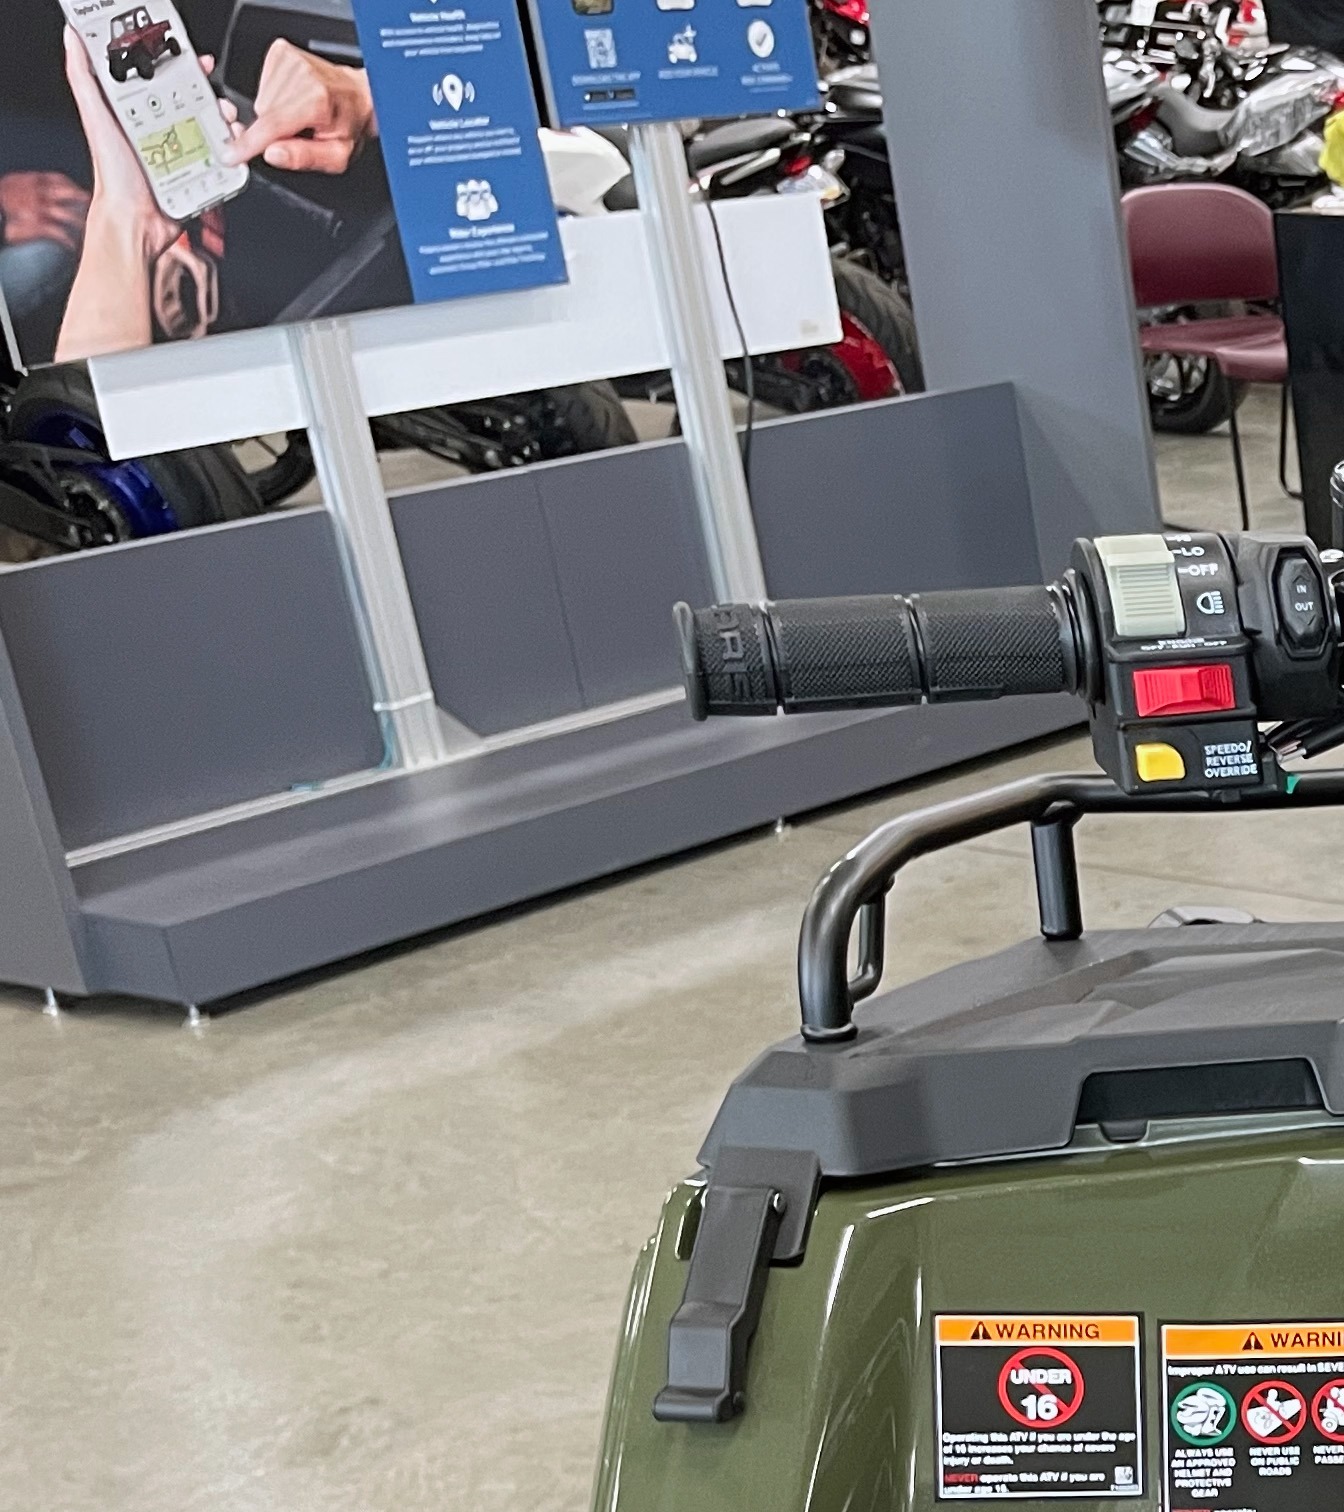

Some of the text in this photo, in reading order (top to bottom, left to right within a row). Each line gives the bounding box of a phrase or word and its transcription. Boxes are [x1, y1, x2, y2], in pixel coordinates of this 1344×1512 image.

[1181, 546, 1205, 556] LO
[1188, 563, 1218, 576] OFF
[1296, 584, 1307, 593] IN
[1295, 601, 1314, 611] OUT
[1206, 753, 1253, 767] REVERSE
[1204, 763, 1258, 778] OVERRIDE
[996, 1324, 1100, 1340] WARNING
[1215, 1364, 1236, 1374] ATV
[1257, 1365, 1276, 1374] can
[1307, 1363, 1316, 1372] in
[1010, 1368, 1072, 1384] UNDER
[1021, 1394, 1058, 1421] 16
[1009, 1432, 1028, 1441] ATV
[1040, 1472, 1059, 1481] ATV
